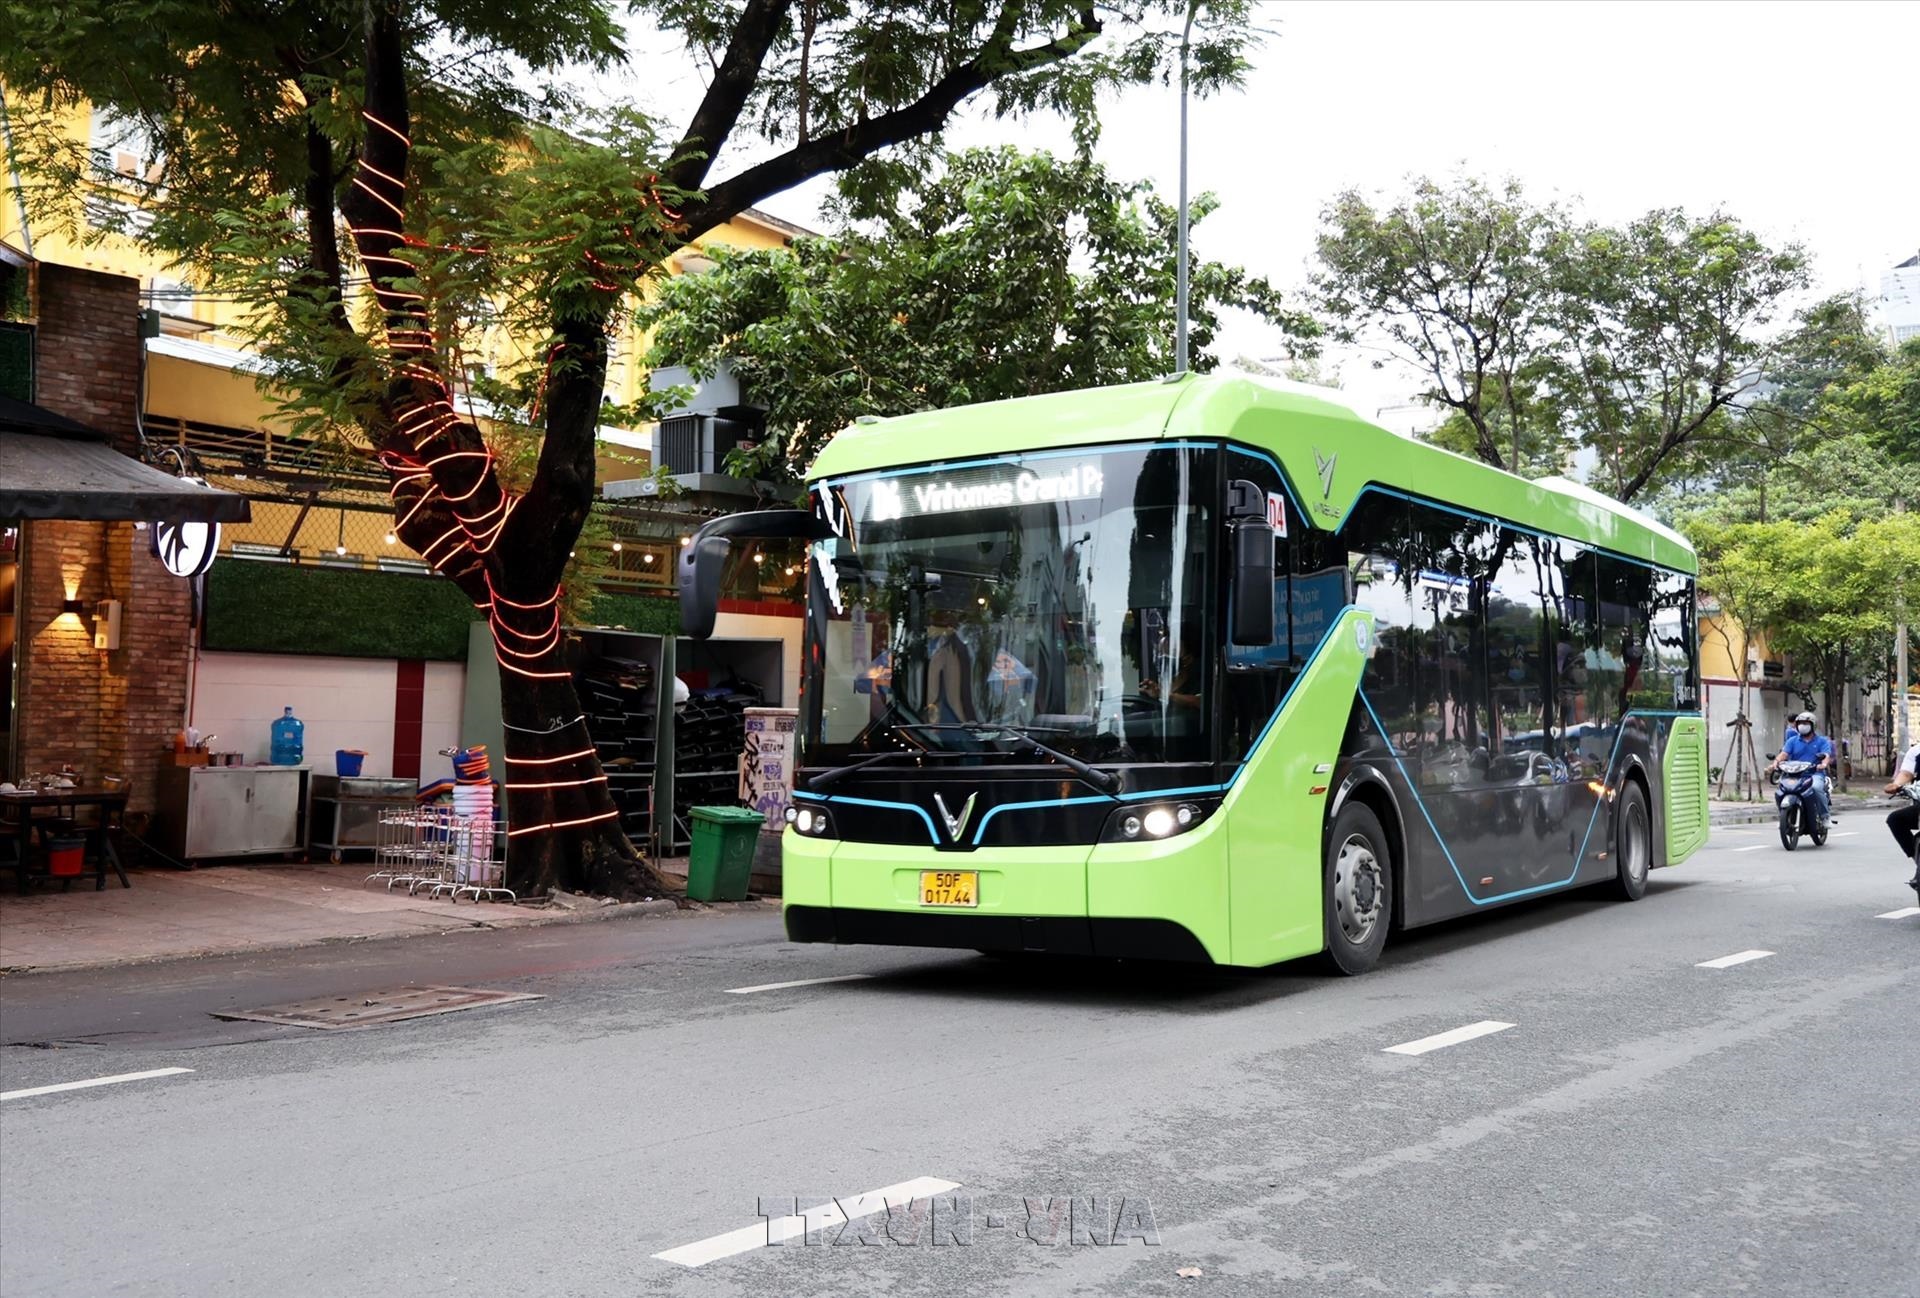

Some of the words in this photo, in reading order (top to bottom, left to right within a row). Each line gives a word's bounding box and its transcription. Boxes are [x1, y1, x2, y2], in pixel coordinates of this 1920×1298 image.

[914, 481, 1013, 512] Vinhomes
[1016, 467, 1078, 503] Grand
[936, 873, 960, 888] 50F
[925, 889, 970, 904] 017.44
